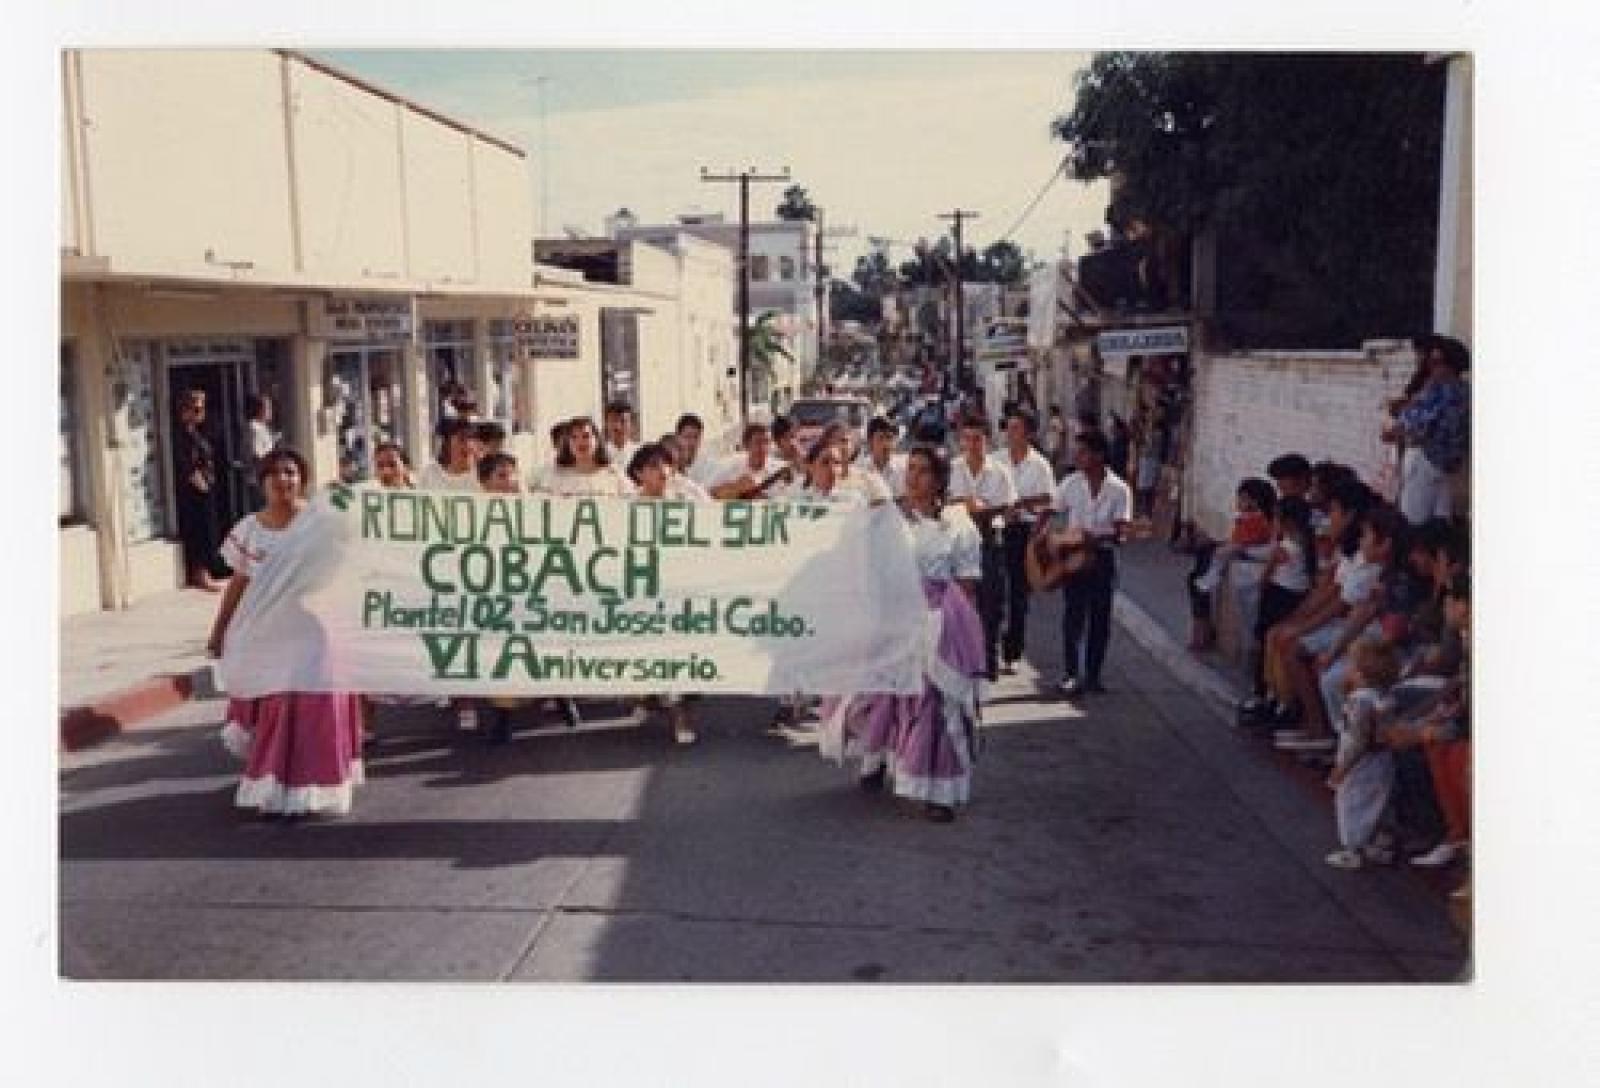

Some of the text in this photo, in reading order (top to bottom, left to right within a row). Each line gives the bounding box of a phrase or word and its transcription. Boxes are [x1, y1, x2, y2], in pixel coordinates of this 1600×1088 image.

[628, 496, 711, 546] DEL
[422, 543, 660, 599] COBACH
[364, 590, 468, 629] Plantel
[521, 598, 587, 635] San
[592, 598, 666, 636] José
[670, 598, 718, 635] del
[725, 596, 816, 637] Cabo.
[420, 632, 480, 680] VI
